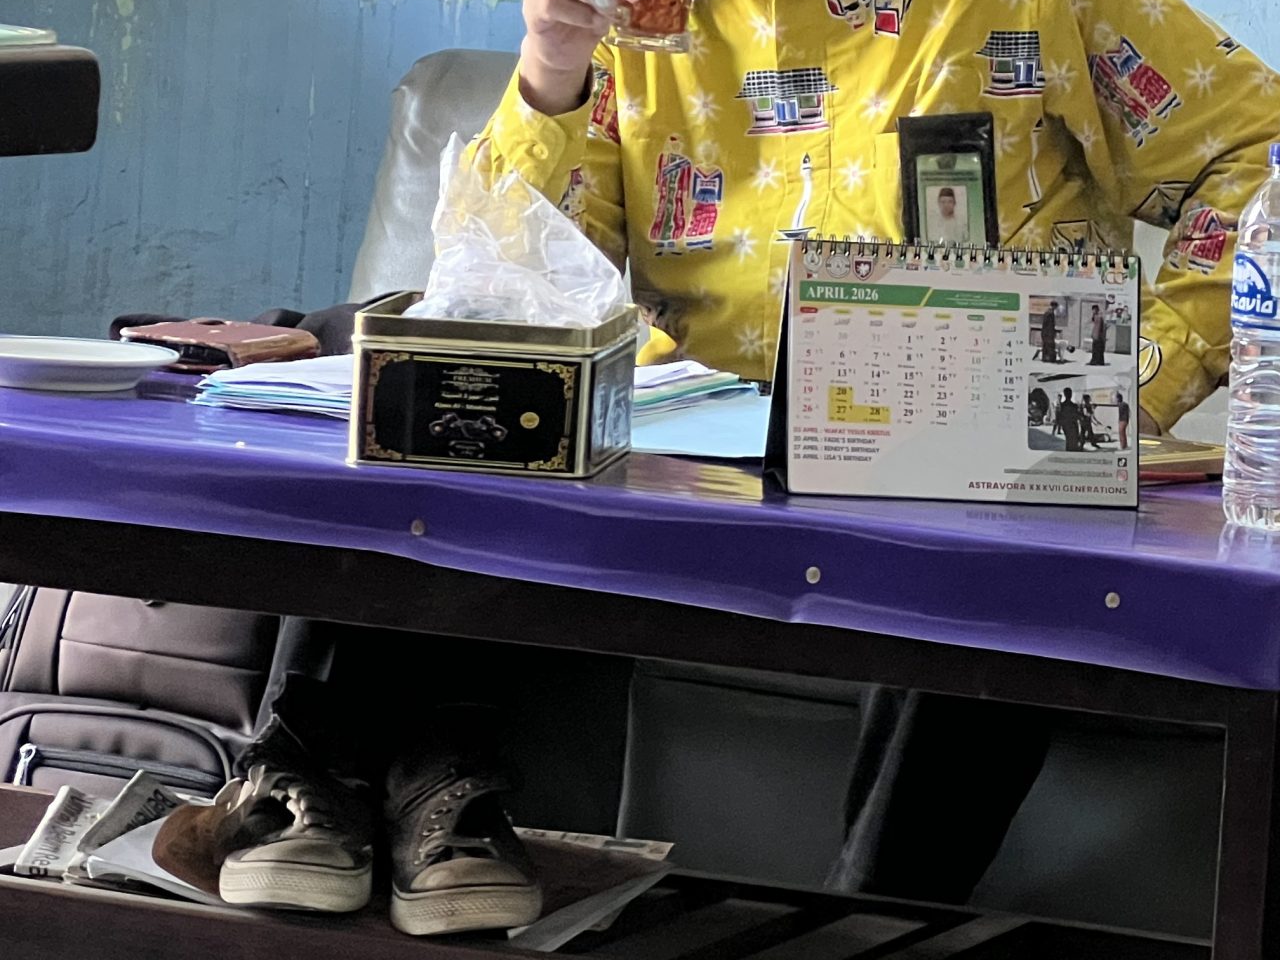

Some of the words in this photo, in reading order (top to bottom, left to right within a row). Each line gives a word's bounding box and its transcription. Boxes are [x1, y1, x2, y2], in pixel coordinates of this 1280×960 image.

[806, 286, 848, 299] APRIL
[851, 287, 879, 301] 2026
[968, 481, 1026, 491] ASTRAVORA
[1028, 484, 1061, 493] XXXVII
[1063, 485, 1128, 495] GENERATIONS
